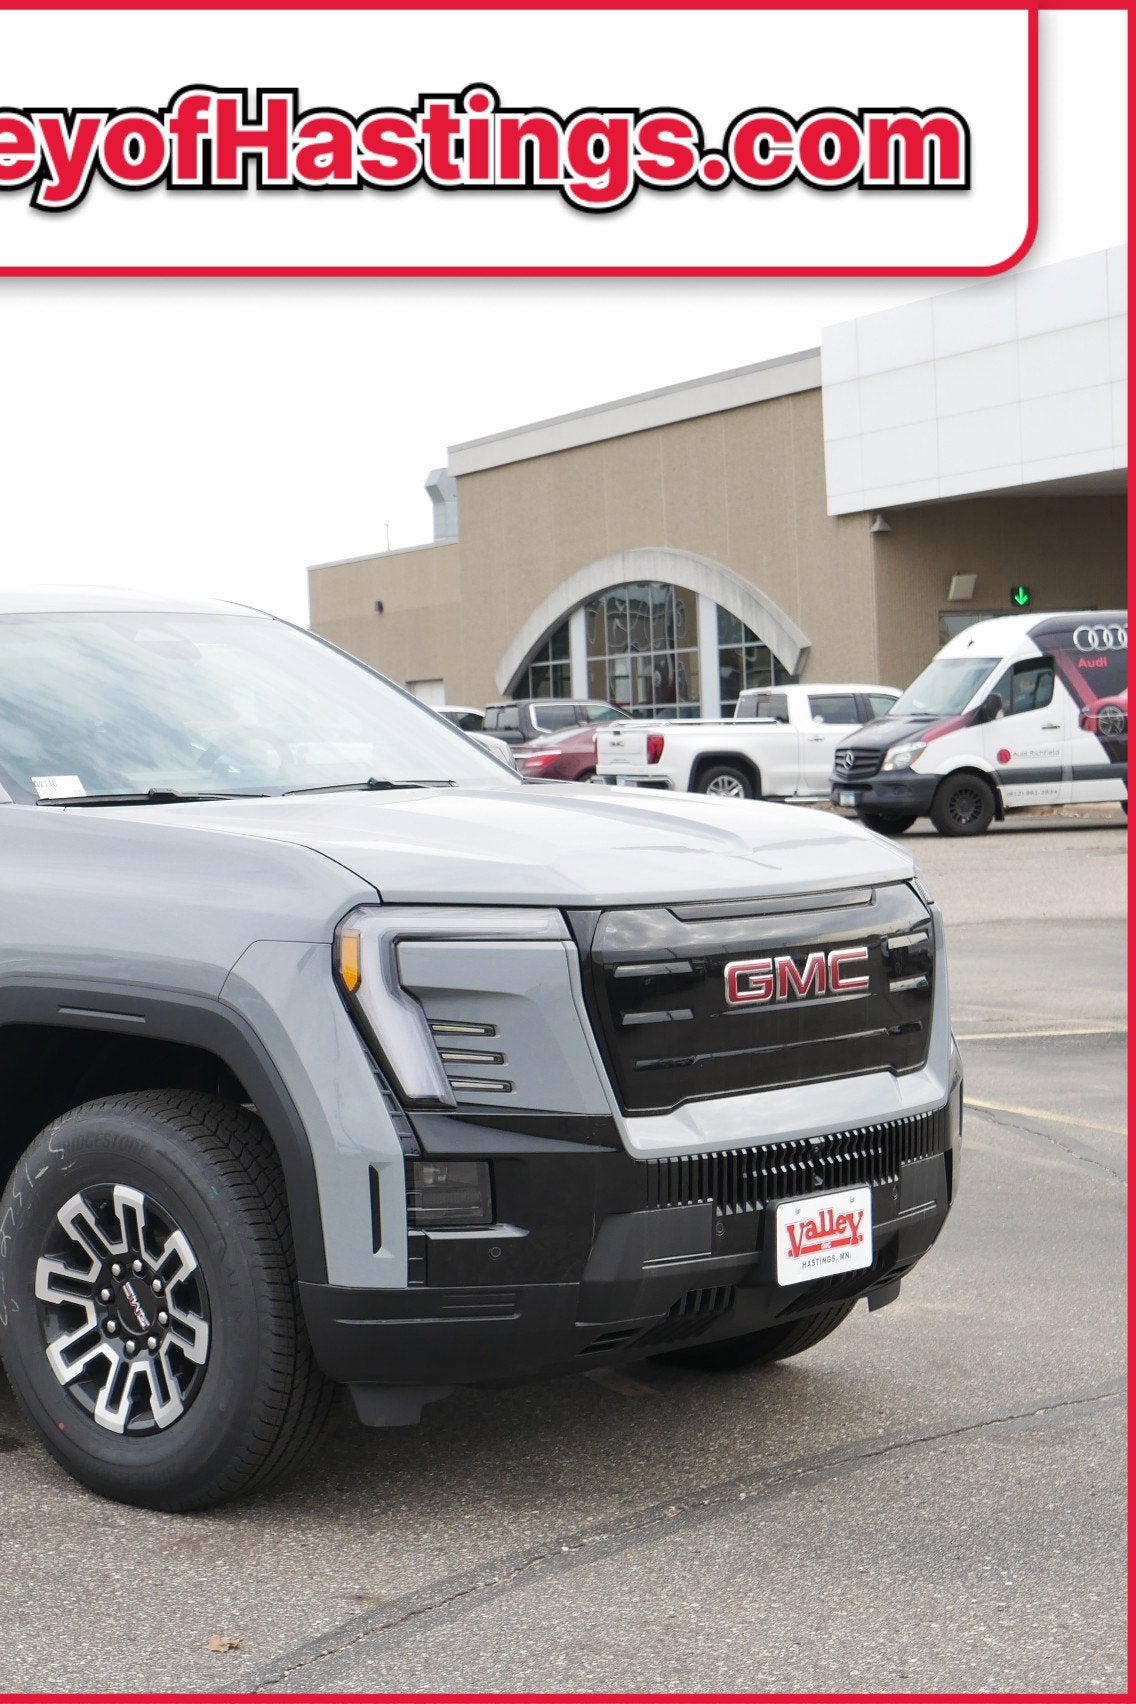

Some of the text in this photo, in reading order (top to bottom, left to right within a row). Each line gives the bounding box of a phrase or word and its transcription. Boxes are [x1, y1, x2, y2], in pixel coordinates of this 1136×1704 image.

[1078, 656, 1109, 669] Audi
[724, 947, 870, 1007] GMC
[785, 1208, 864, 1258] Valley
[802, 1255, 838, 1269] HASTINGS,
[123, 1282, 150, 1330] GMC
